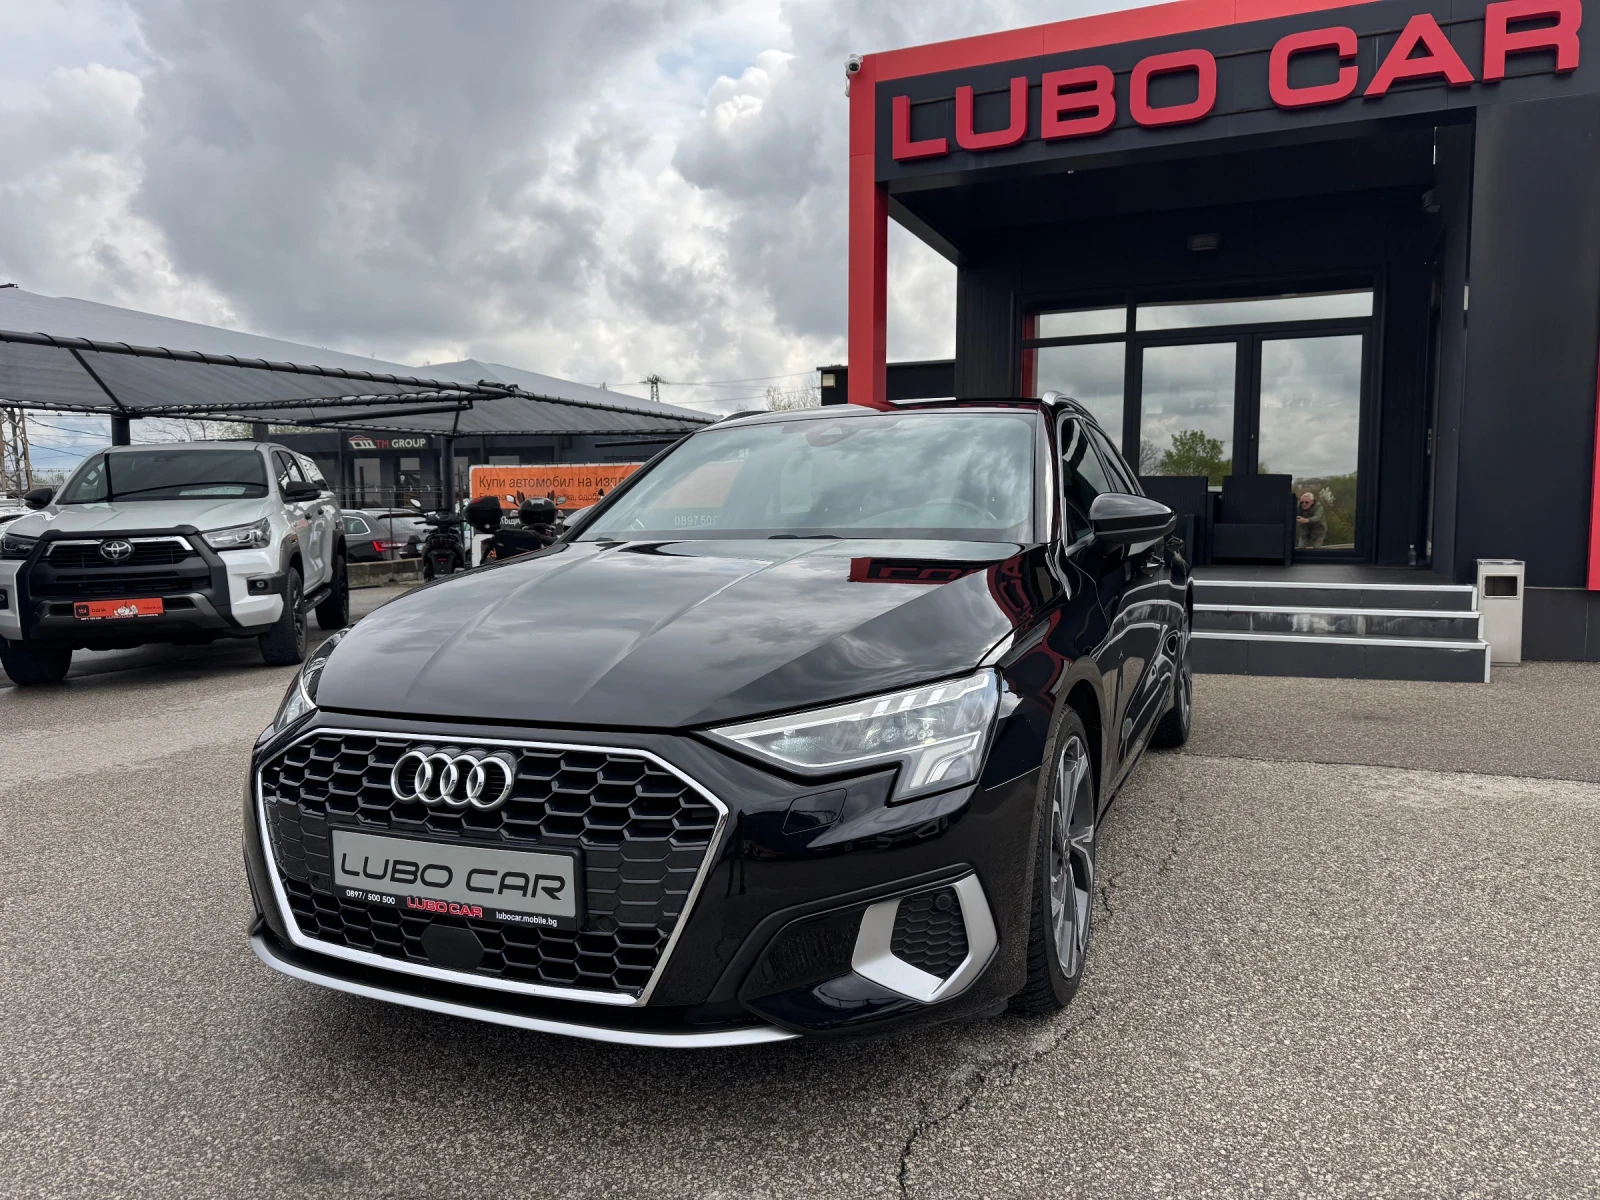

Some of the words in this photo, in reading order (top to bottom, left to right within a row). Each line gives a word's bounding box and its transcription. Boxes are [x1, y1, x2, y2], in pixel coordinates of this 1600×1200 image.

[892, 49, 1217, 161] LUBO
[1268, 0, 1583, 110] CAR
[375, 440, 390, 448] TM
[391, 438, 426, 448] GROUP
[479, 475, 506, 490] Купи
[508, 475, 574, 488] автомобил
[577, 477, 592, 487] на
[340, 853, 454, 889] LUBO
[465, 868, 566, 900] CAR
[345, 889, 366, 900] 0897/
[367, 892, 381, 902] 500
[382, 894, 396, 905] 500
[406, 897, 448, 913] LUBO
[449, 902, 483, 918] CAR
[495, 911, 558, 928] lubocar.mobile.bg
